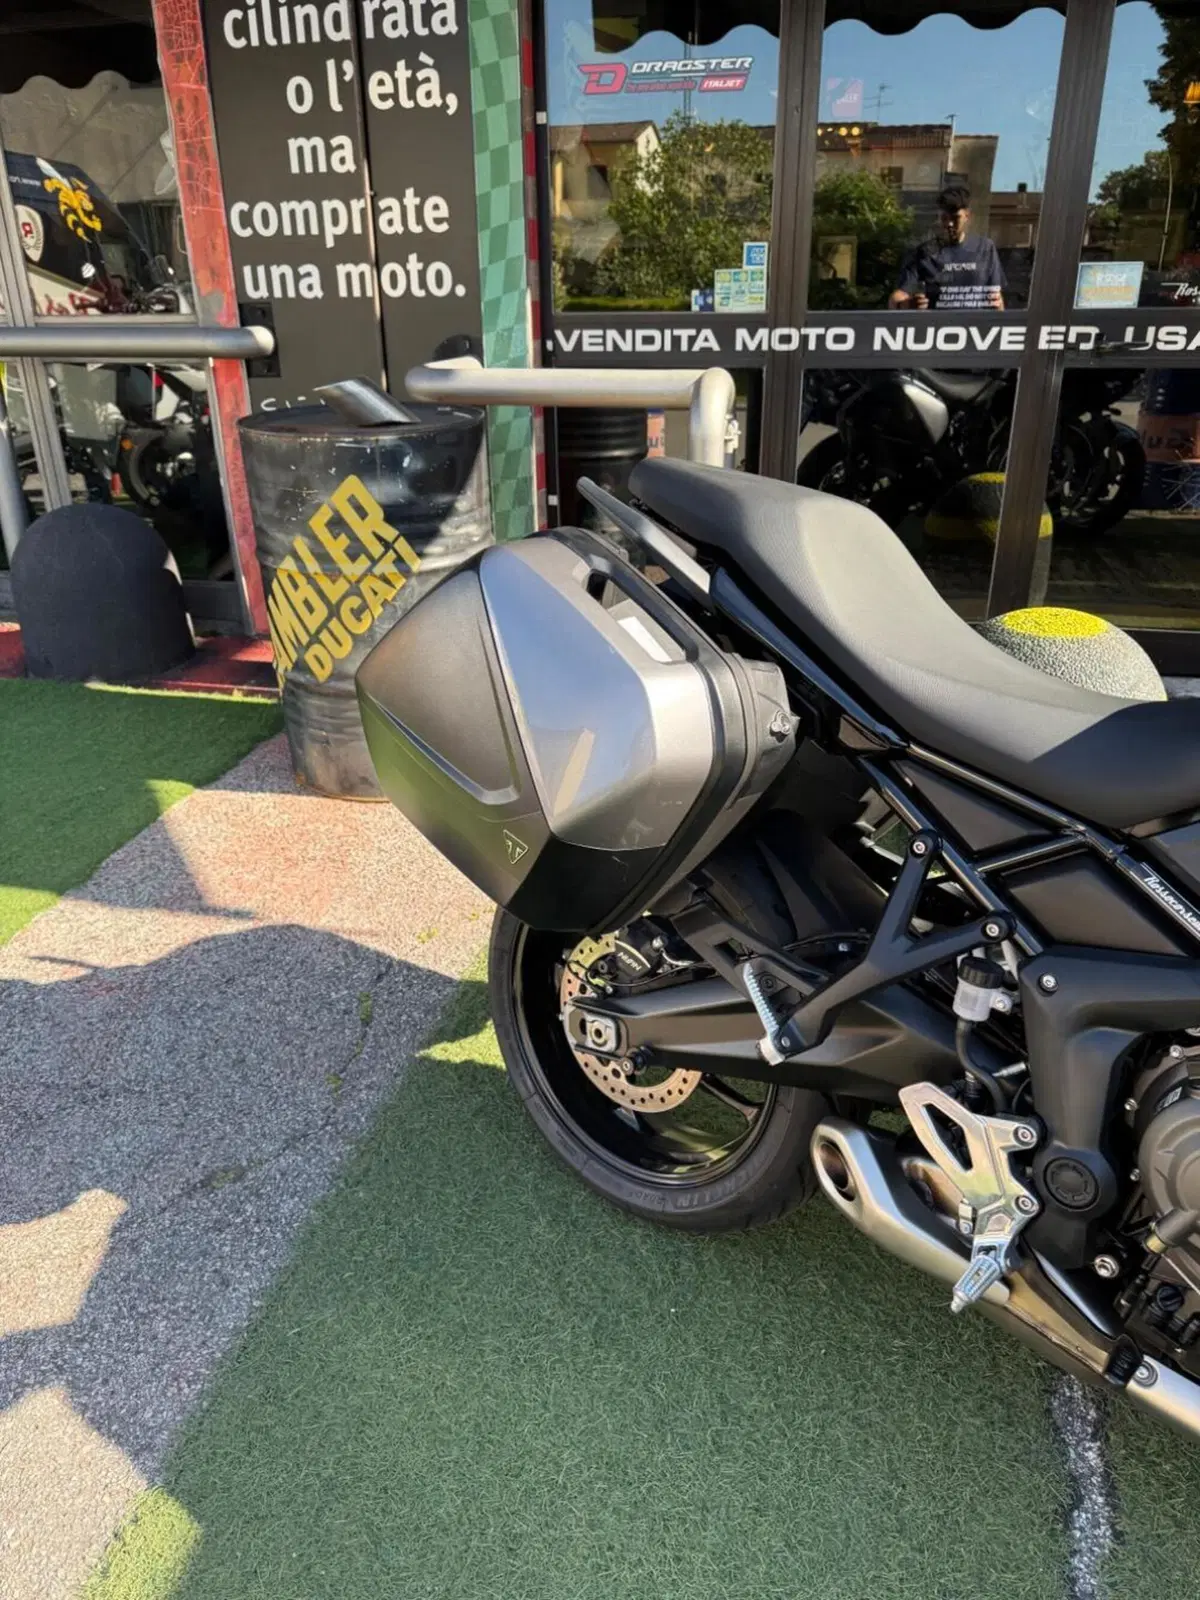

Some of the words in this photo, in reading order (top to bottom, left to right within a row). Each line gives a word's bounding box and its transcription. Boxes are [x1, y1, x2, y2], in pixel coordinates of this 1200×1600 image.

[631, 57, 752, 74] DRAGSTER
[703, 78, 743, 88] ITALJET
[286, 76, 314, 114] o
[288, 135, 357, 174] ma
[243, 263, 324, 299] una
[336, 252, 467, 298] moto.
[554, 328, 721, 352] VENDITA
[735, 327, 856, 351] MOTO
[873, 326, 1027, 351] NUOVE
[304, 535, 421, 684] DUCATI
